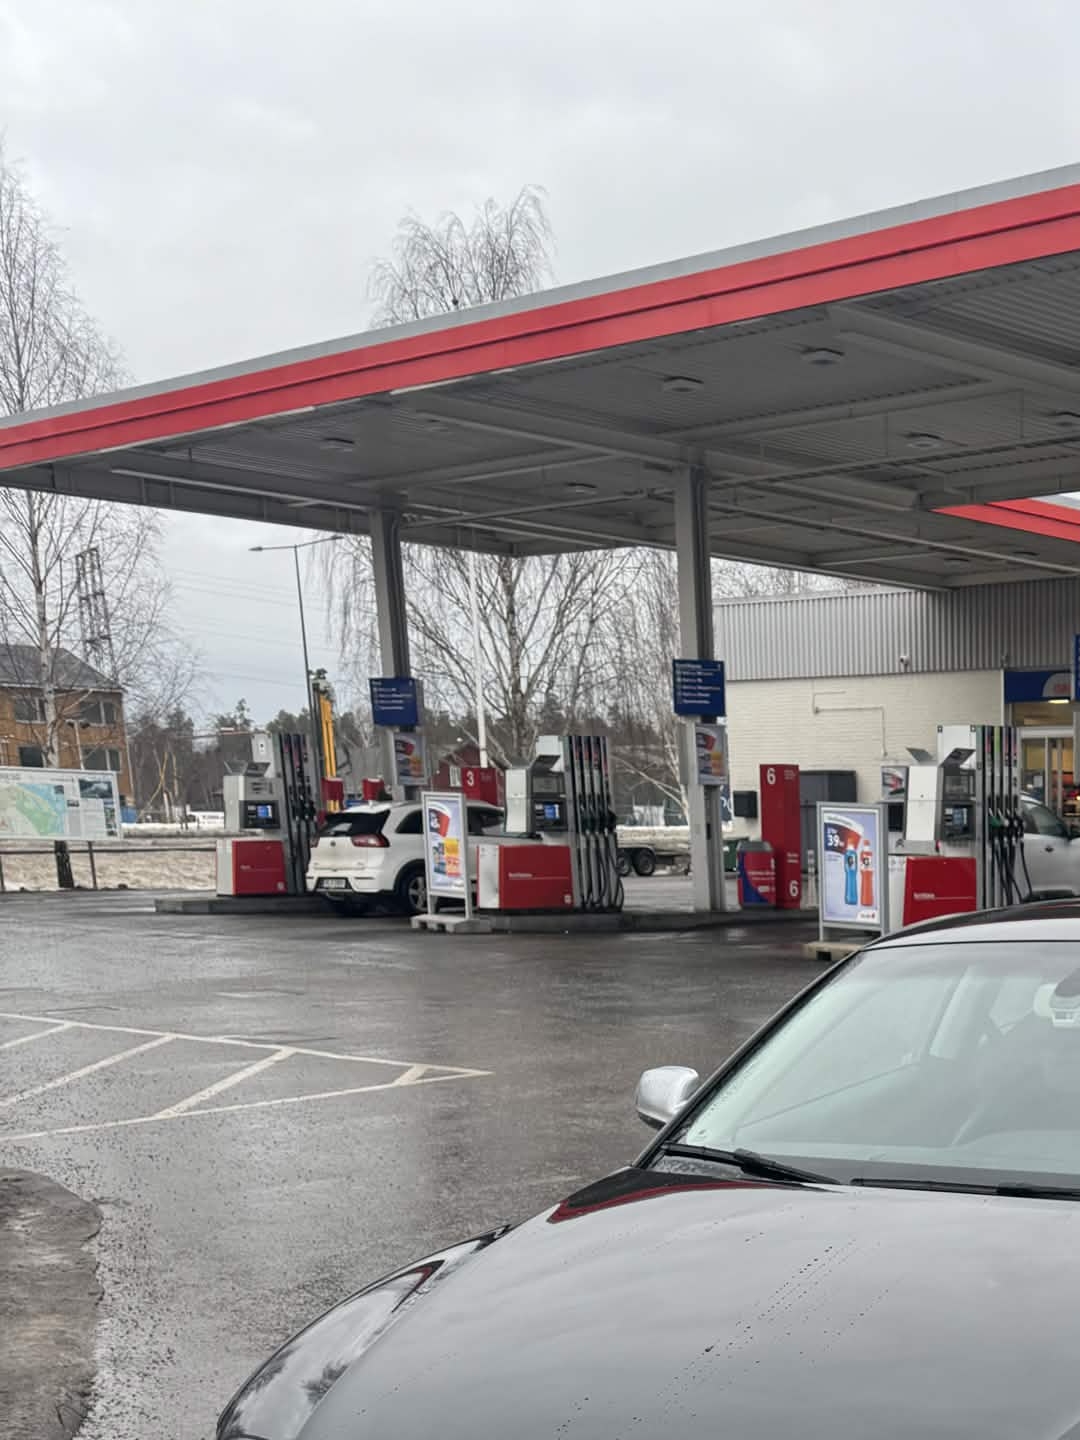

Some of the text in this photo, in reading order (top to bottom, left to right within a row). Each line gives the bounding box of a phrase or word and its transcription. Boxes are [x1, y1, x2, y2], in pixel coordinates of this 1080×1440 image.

[466, 770, 475, 787] 3
[767, 768, 776, 785] 6
[827, 835, 840, 847] 39
[789, 880, 799, 897] 6
